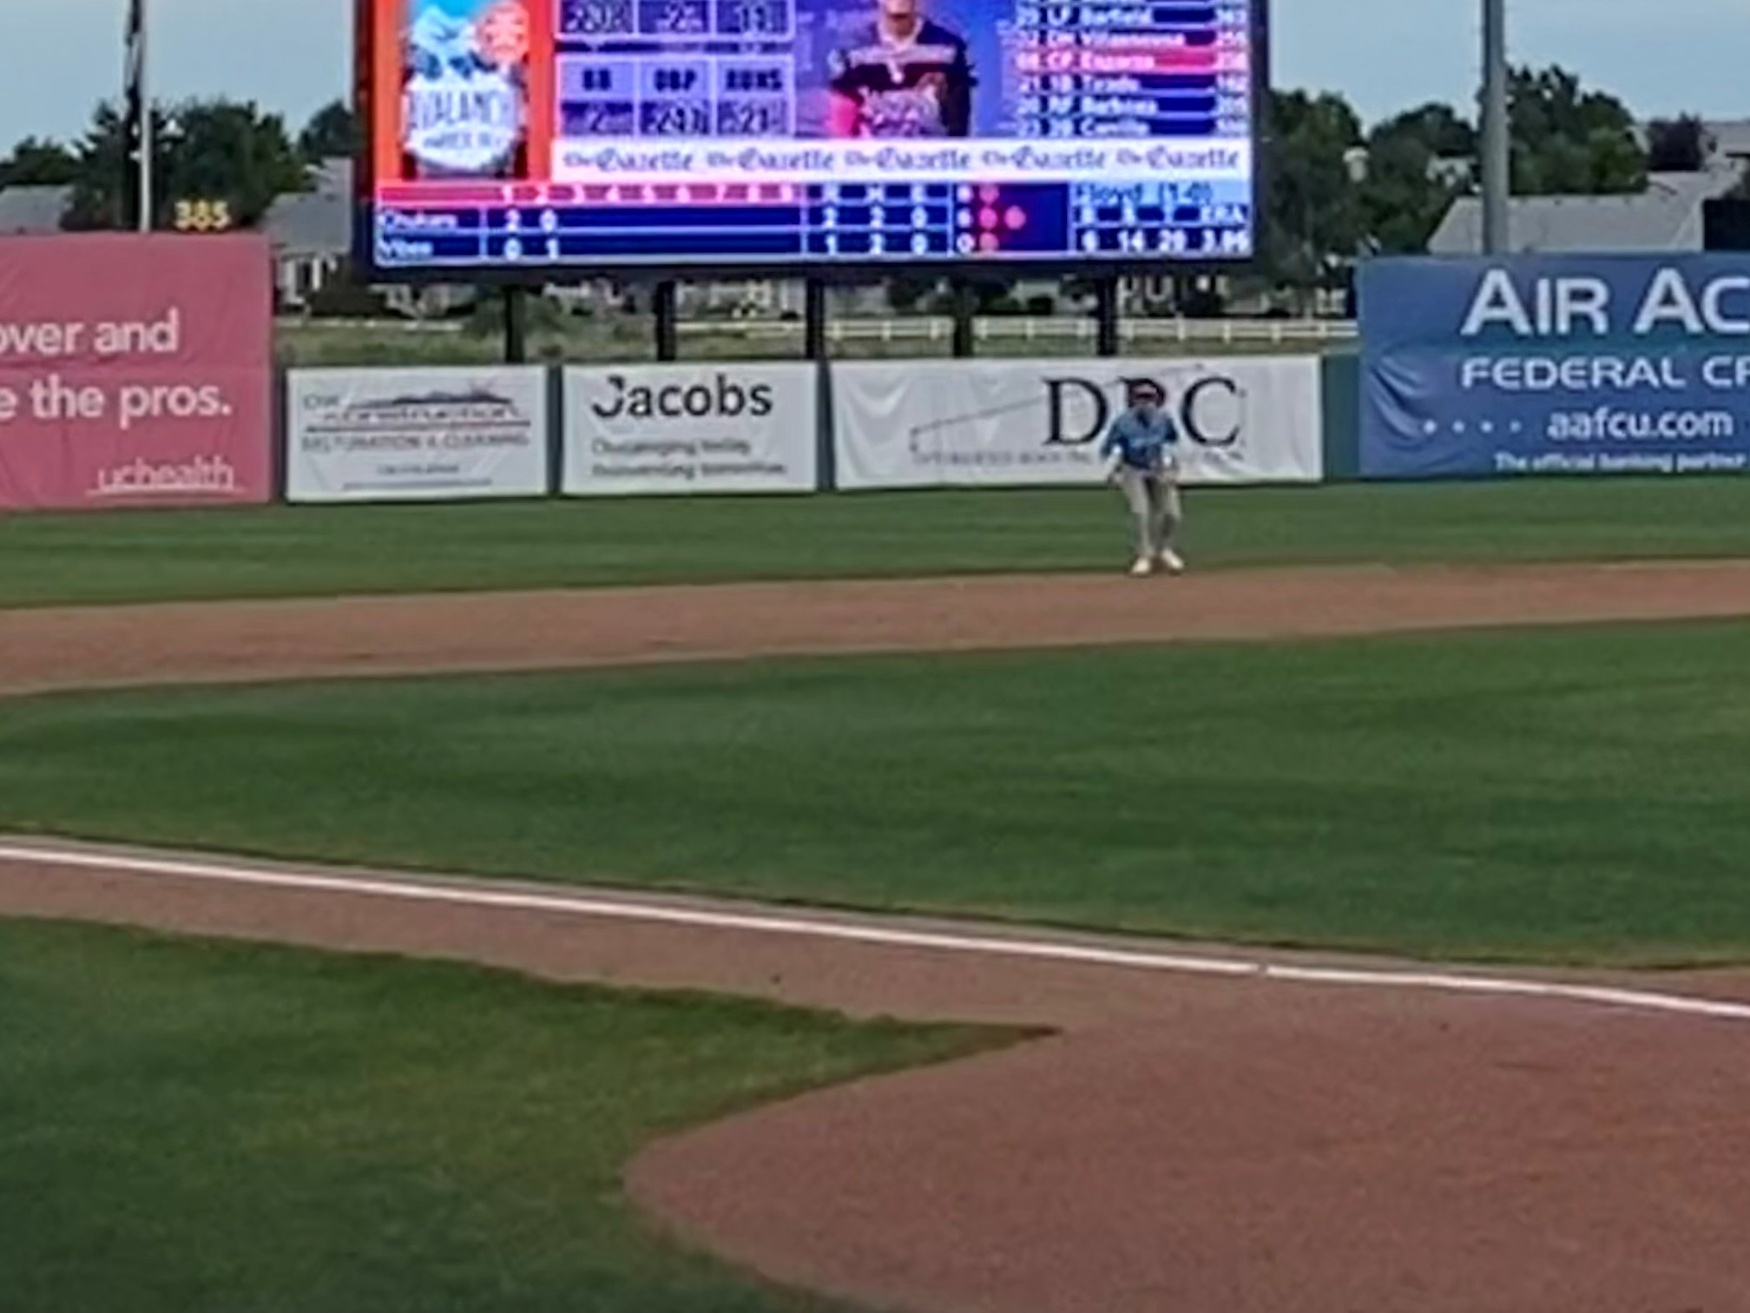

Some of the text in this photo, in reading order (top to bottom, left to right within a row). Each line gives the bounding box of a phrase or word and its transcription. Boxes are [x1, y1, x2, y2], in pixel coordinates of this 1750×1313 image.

[594, 146, 693, 171] Gazette
[737, 146, 834, 171] Gazette
[875, 146, 971, 171] Gazette
[1009, 146, 1105, 171] Gazette
[1145, 146, 1239, 171] Gazette
[172, 200, 229, 230] 385
[504, 208, 521, 232] 2
[540, 208, 557, 232] 0
[503, 238, 522, 262] 0
[546, 238, 560, 261] 1
[1460, 269, 1612, 335] AIR
[94, 305, 180, 355] and
[1460, 355, 1688, 390] FEDERAL
[30, 373, 105, 419] the
[119, 385, 233, 431] pros.
[592, 372, 774, 419] Jacobs
[1547, 406, 1734, 440] aafcu.com
[97, 453, 236, 490] uchealth
